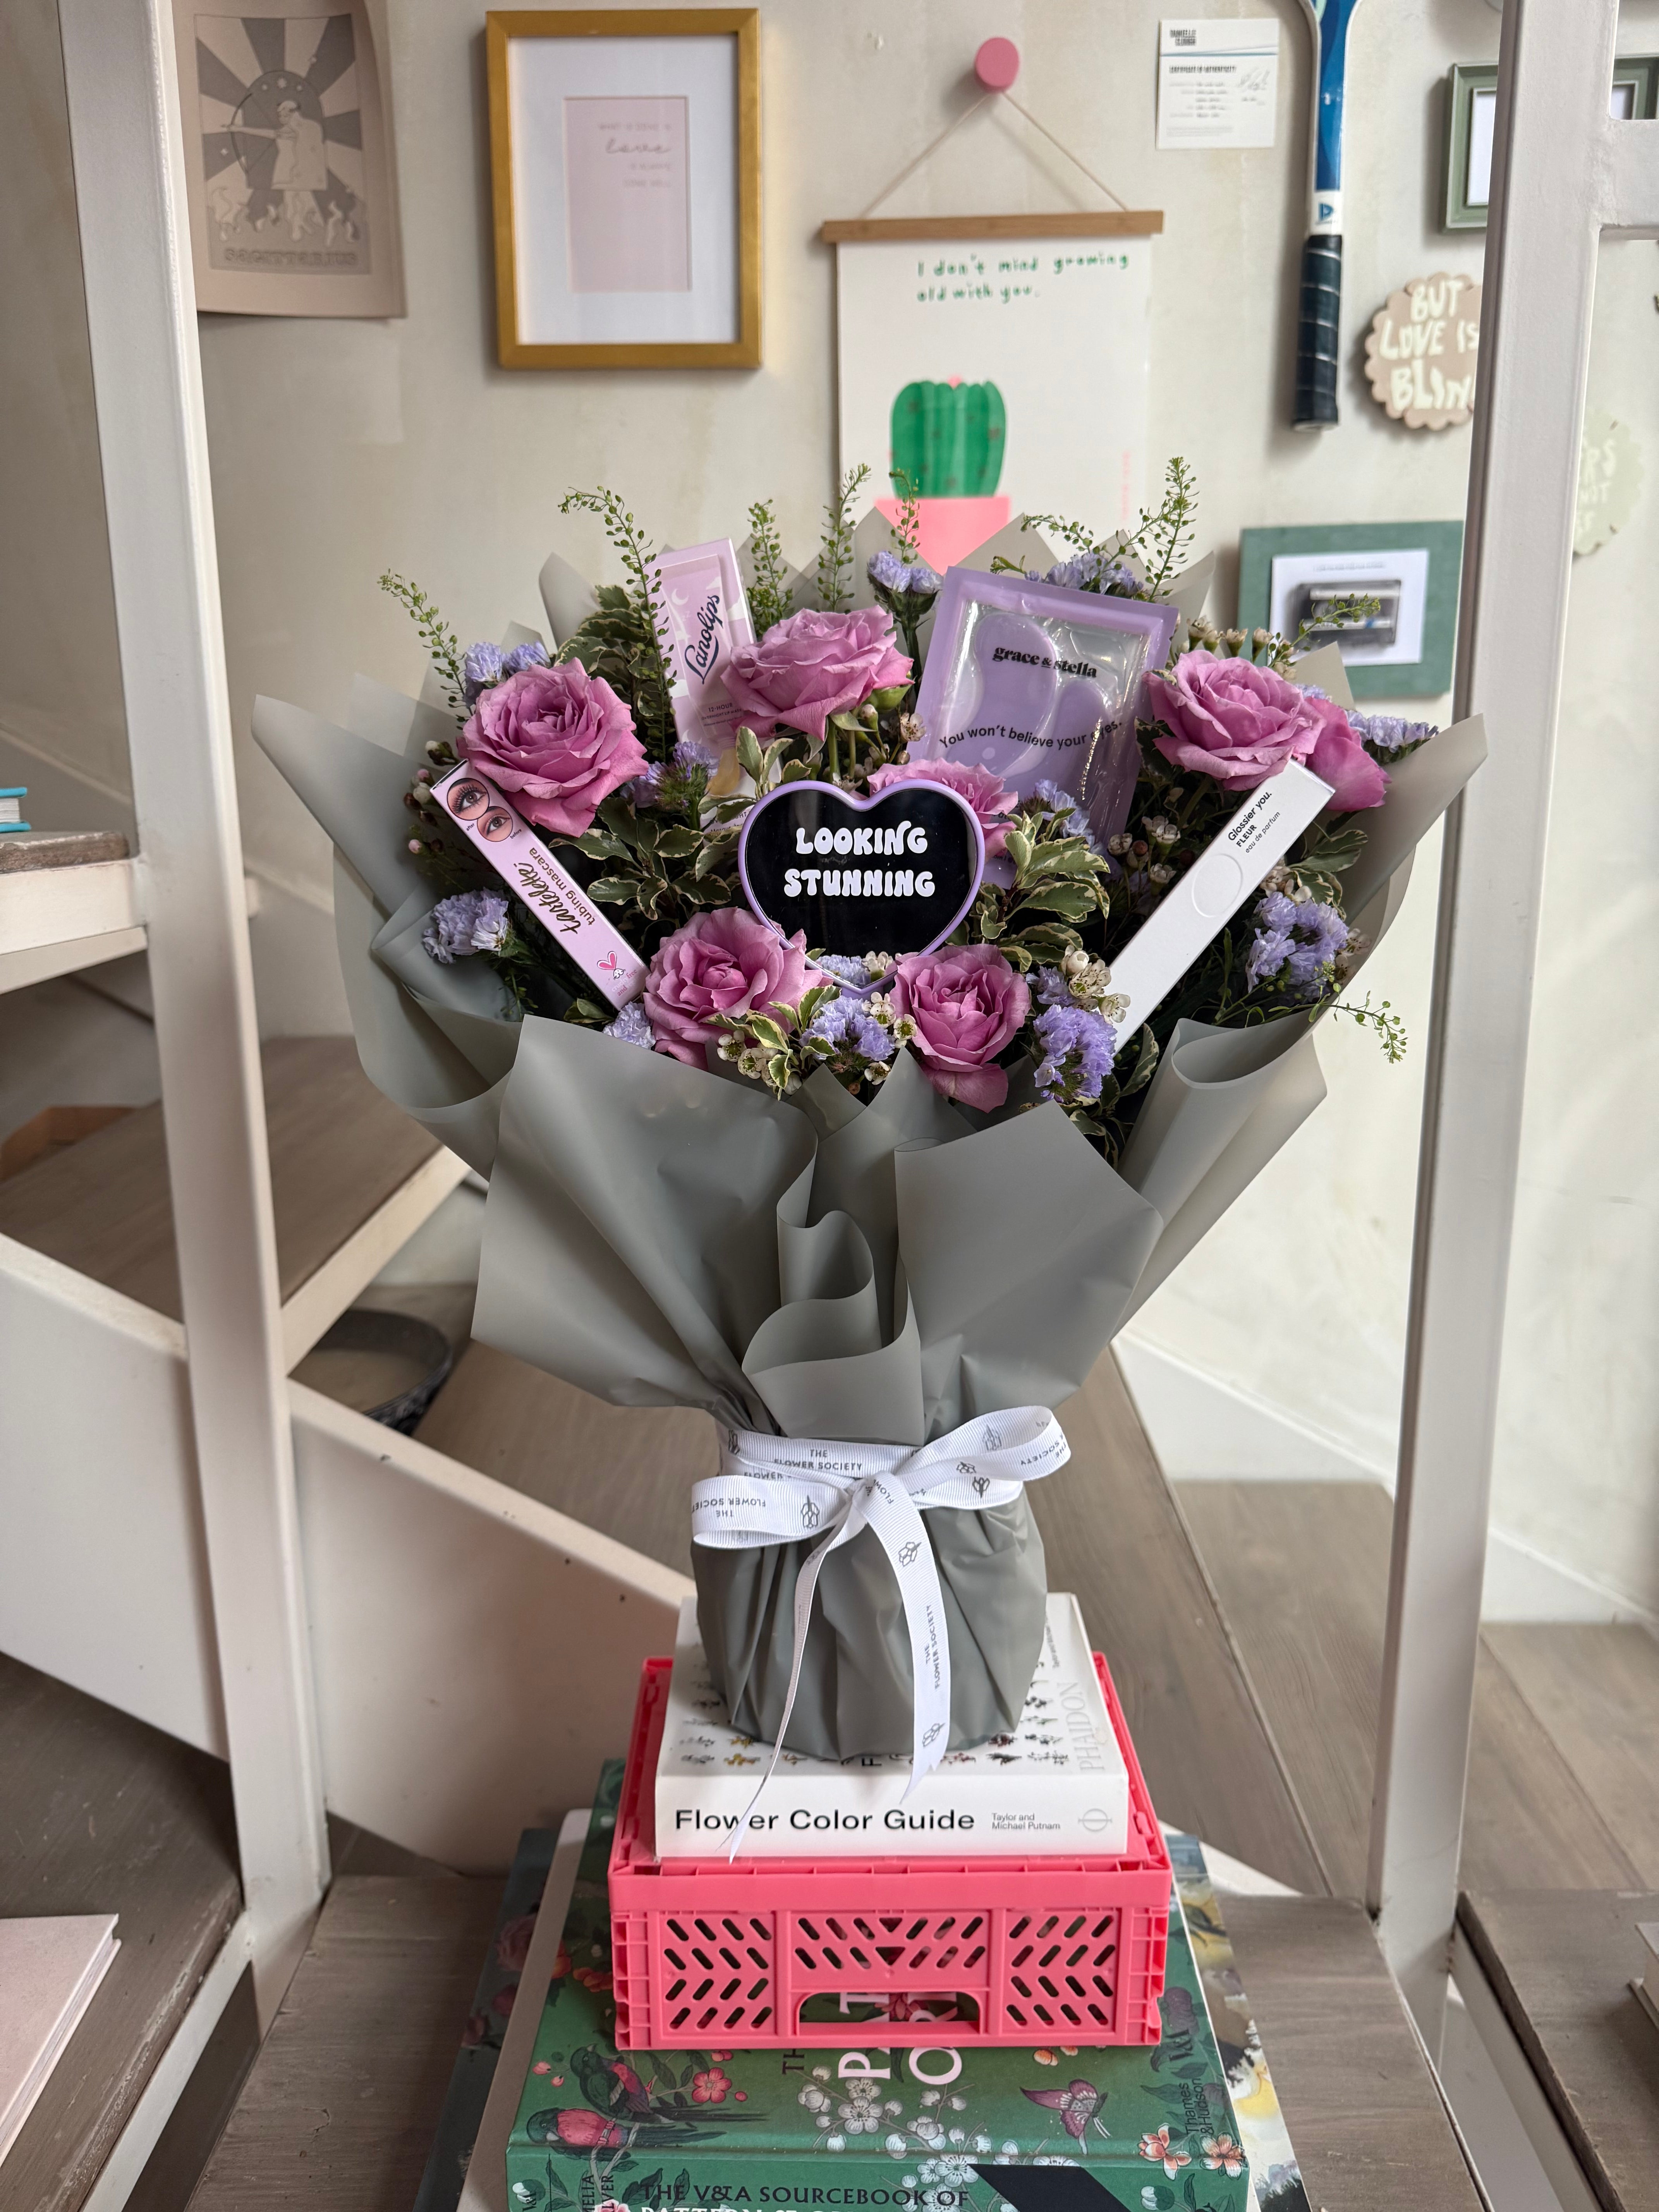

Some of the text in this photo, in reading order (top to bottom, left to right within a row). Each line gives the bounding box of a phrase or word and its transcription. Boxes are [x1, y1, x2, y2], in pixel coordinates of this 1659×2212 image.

[918, 250, 1129, 277] I don't mind growing
[917, 282, 1040, 304] old with you.
[1411, 280, 1463, 323] BUT
[1379, 318, 1479, 360] LOVE IS
[685, 595, 723, 685] Lanolips
[992, 647, 1097, 678] grace & stella
[939, 732, 964, 748] You
[968, 725, 1006, 738] won't
[1009, 727, 1053, 747] believe
[1057, 734, 1087, 750] your
[466, 823, 475, 831] after
[1228, 792, 1272, 840] Glossier you.
[510, 829, 522, 839] before
[796, 821, 928, 855] LOOKING
[1236, 825, 1257, 847] FLEUR
[1245, 812, 1280, 853] eau de parfum
[529, 847, 595, 926] tubing mascara
[784, 869, 935, 897] STUNNING
[518, 862, 581, 934] tartelette
[617, 985, 628, 996] and
[774, 1459, 862, 1471] FLOWER SOCIETY
[810, 1449, 828, 1457] THE
[1021, 1440, 1060, 1465] SOCIETY
[728, 1498, 766, 1507] FLOWER
[926, 1605, 937, 1648] SOCIETY
[1057, 1682, 1105, 1771] PHAIDON
[675, 1809, 975, 1830] Flower Color Guide
[991, 1812, 1016, 1822] Taylor
[991, 1821, 1061, 1830] Michael Putnam
[1179, 2082, 1199, 2135] Thames
[1192, 2078, 1214, 2135] &Hudson
[640, 2185, 969, 2207] THE V&A SOURCEBOOK OF
